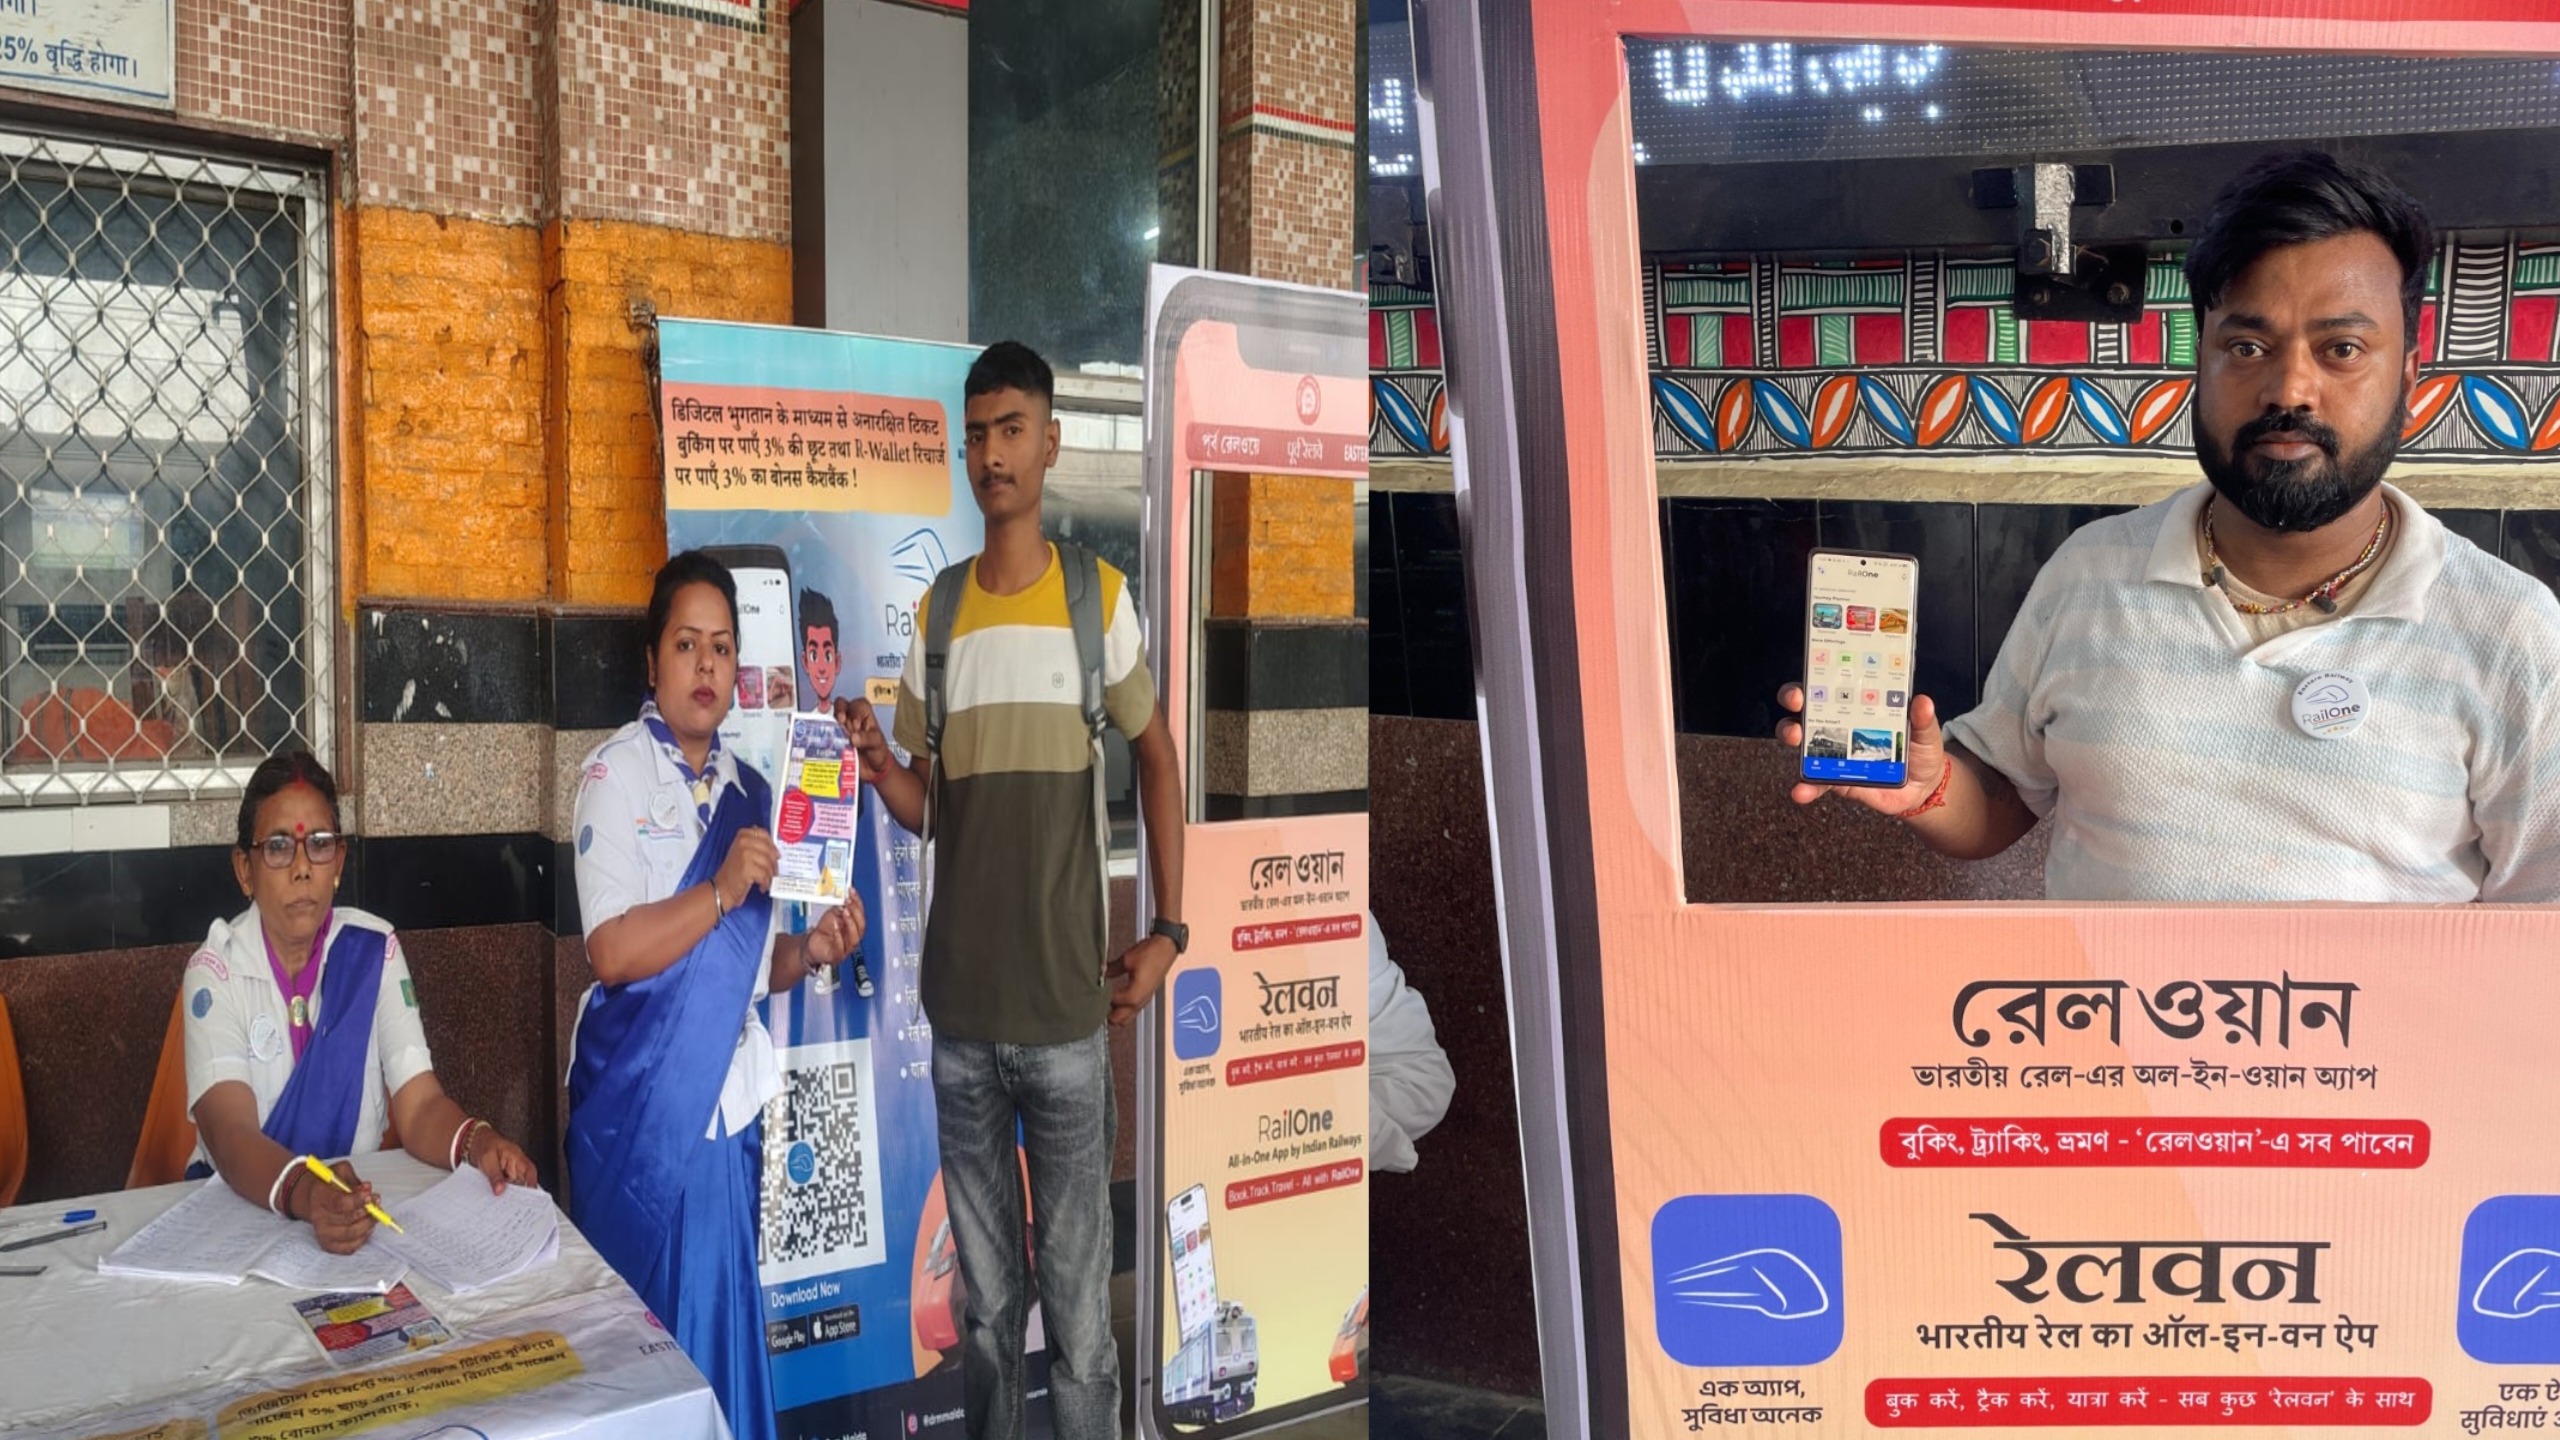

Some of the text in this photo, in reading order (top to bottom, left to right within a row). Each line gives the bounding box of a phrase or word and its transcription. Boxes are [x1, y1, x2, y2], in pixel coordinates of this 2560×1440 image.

[0, 36, 38, 64] 5%
[44, 39, 84, 72] वृद्धि
[671, 397, 939, 436] डिजिटल भुगतान के माध्यम से अनारक्षित टिकट
[677, 430, 715, 458] बुकिंग
[718, 436, 734, 454] पर
[764, 436, 785, 457] 3%
[787, 432, 803, 457] की
[806, 440, 826, 464] छूट
[829, 440, 851, 458] तथा
[855, 438, 910, 463] R-Wallet
[913, 441, 945, 465] रिचार्ज
[674, 467, 691, 485] पर
[723, 466, 747, 488] 3%
[750, 467, 767, 486] का
[770, 462, 802, 487] बोनस
[2301, 704, 2360, 725] RailOne
[1253, 971, 1340, 1016] रेलवन
[1239, 1023, 1268, 1043] भारतीय
[1269, 1021, 1281, 1040] रेल
[1283, 1023, 1294, 1039] का
[1911, 1056, 2378, 1091] ভারতীয় রেল-এর অল-ইন-ওয়ান অ্যাপ
[1258, 1108, 1334, 1143] RailOne
[1228, 1134, 1362, 1168] All-in-One App by Indian Railways
[1898, 1124, 1965, 1161] বুকিং,
[2055, 1130, 2109, 1153] ভ্রমণ
[2296, 1133, 2332, 1154] সব
[2340, 1131, 2414, 1155] পাবেন
[1331, 1167, 1360, 1181] RailOne
[1969, 1213, 2331, 1304] रेलवन
[771, 1281, 840, 1308] Download Now
[771, 1330, 805, 1349] Google Play
[825, 1320, 856, 1339] App Store
[1916, 1314, 2378, 1353] भारतीय रेल का ऑल-इन-वन ऐप
[1699, 1380, 1805, 1398] এক অ্যাপ,
[1886, 1393, 1919, 1418] बुक
[1929, 1388, 1965, 1411] करें,
[1976, 1388, 2010, 1412] ट्रैक
[2019, 1388, 2055, 1410] करें,
[2067, 1392, 2109, 1408] यात्रा
[2119, 1387, 2150, 1408] करें
[2178, 1391, 2210, 1407] सब
[2220, 1391, 2257, 1416] कुछ
[2346, 1387, 2364, 1408] के
[2375, 1392, 2416, 1407] साथ
[2498, 1383, 2541, 1402] एक
[1682, 1404, 1823, 1431] সুবিধা অনেক
[2460, 1404, 2548, 1435] सुविधाएं
